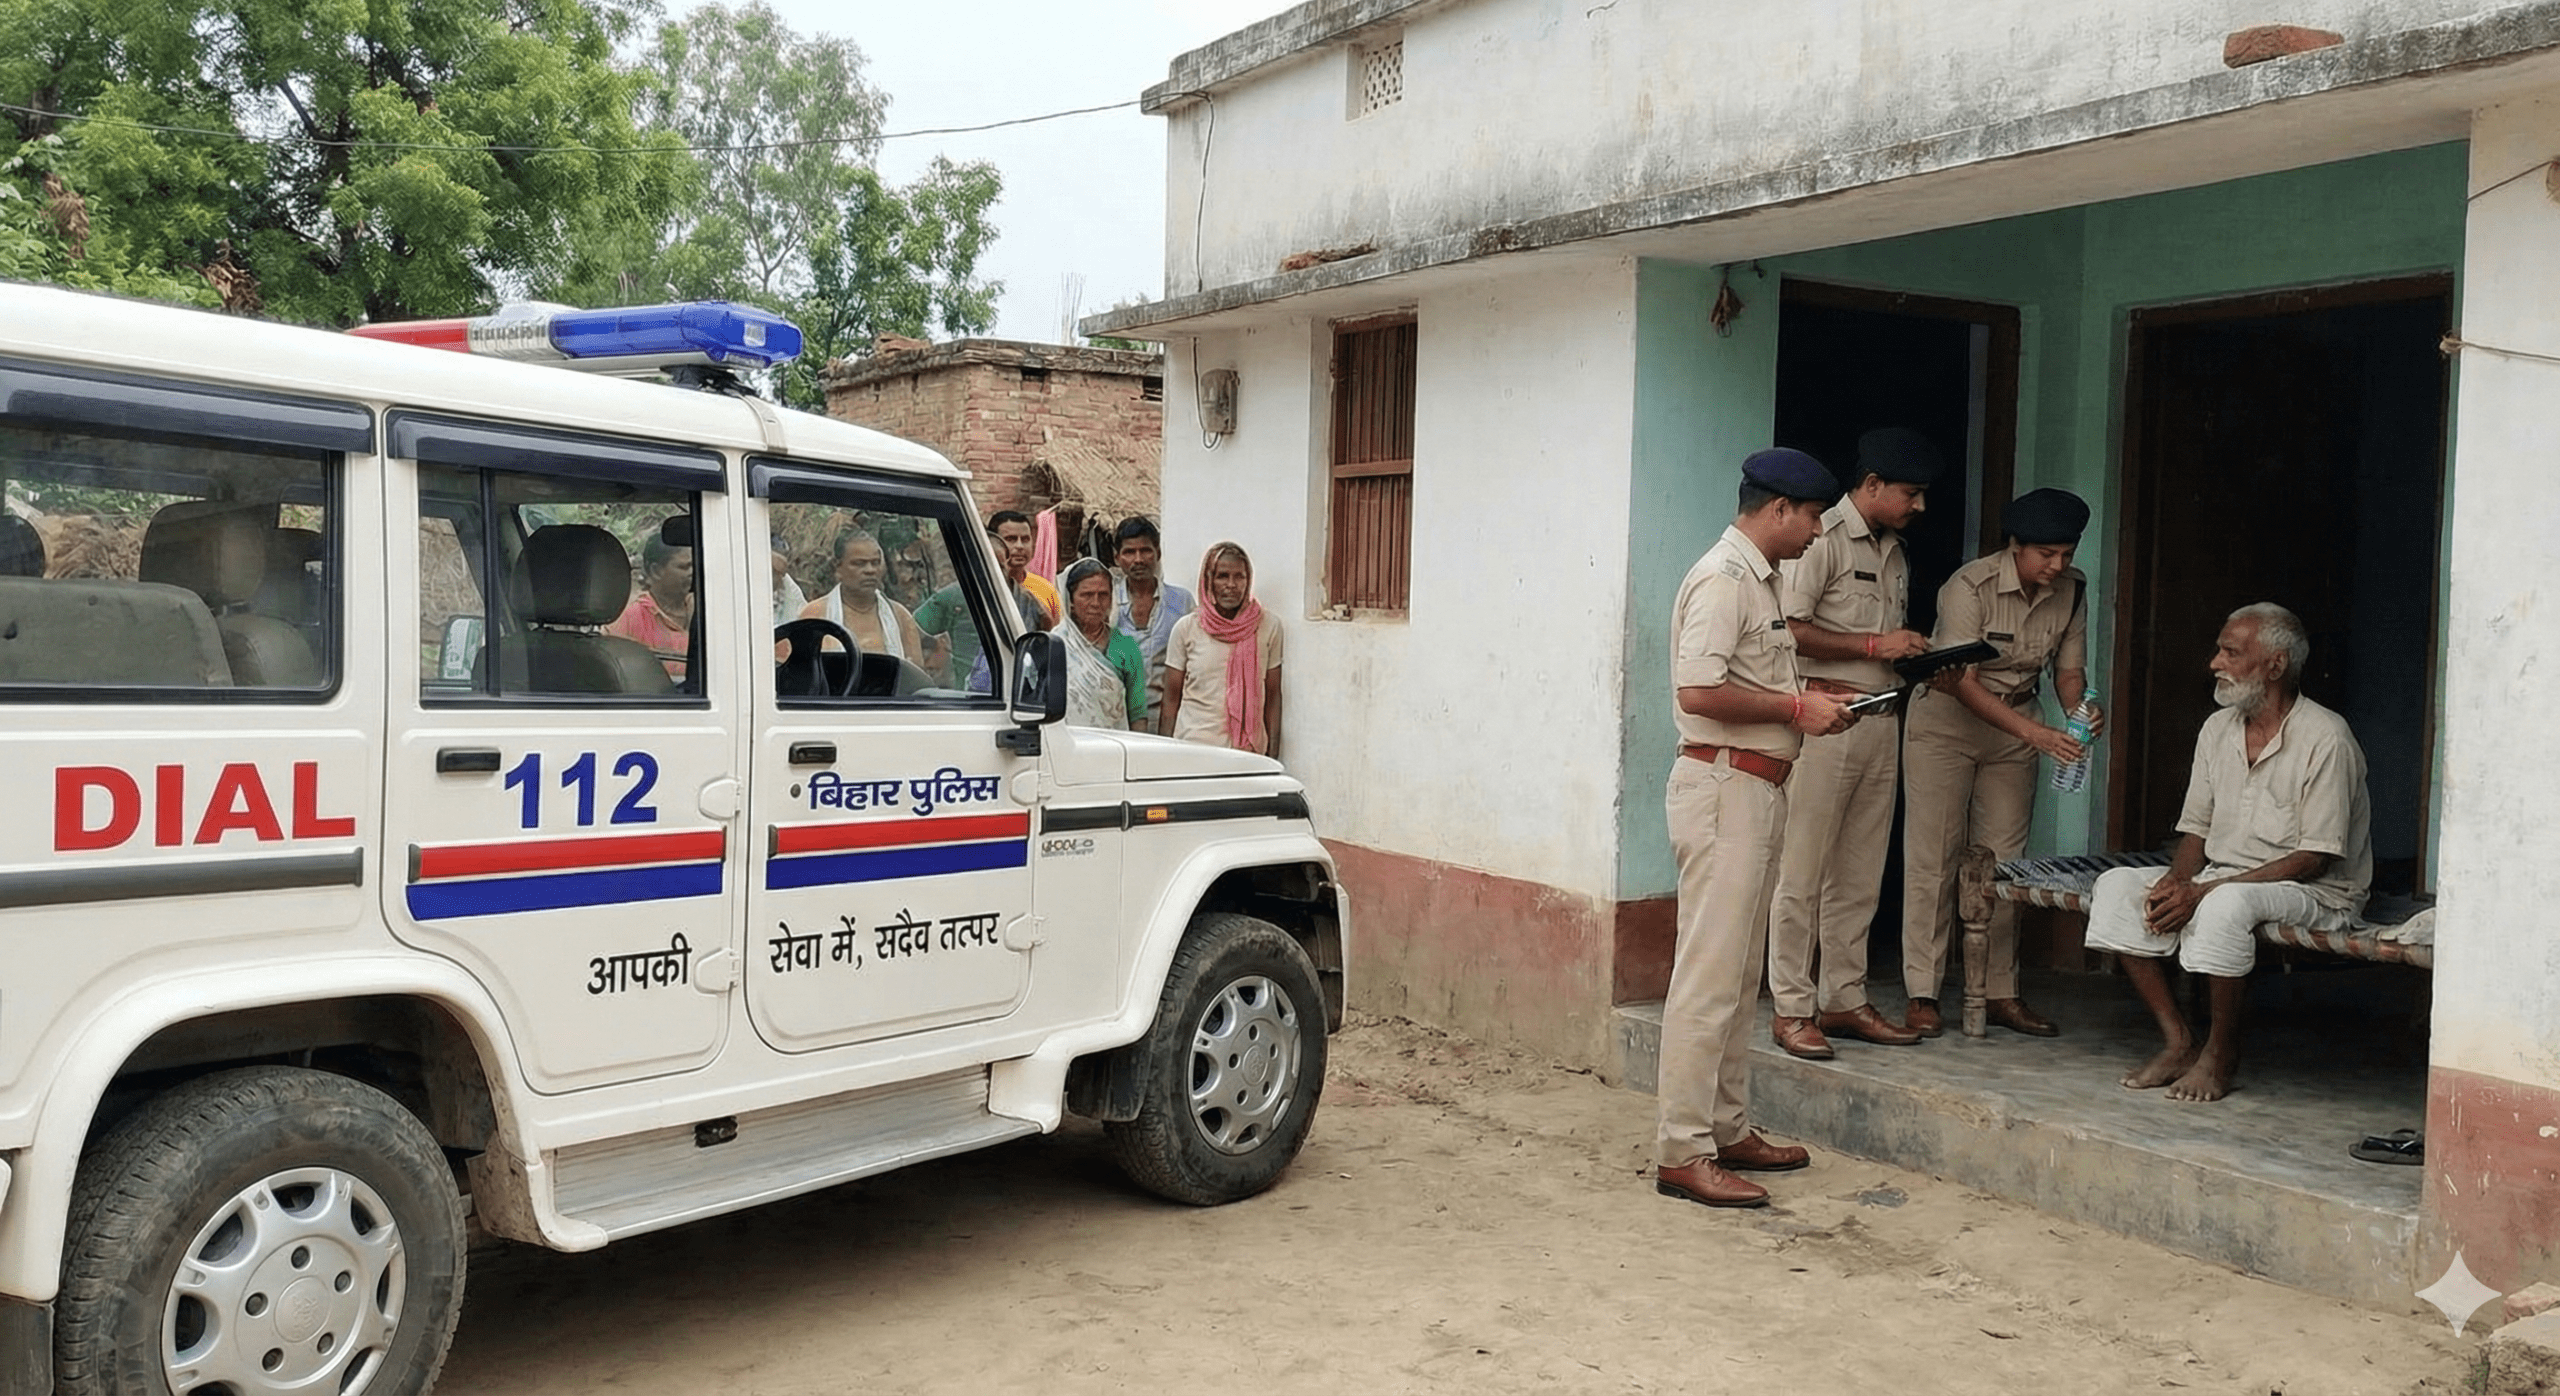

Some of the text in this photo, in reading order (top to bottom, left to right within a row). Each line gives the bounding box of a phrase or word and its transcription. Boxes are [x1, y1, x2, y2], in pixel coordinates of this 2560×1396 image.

[54, 752, 660, 852] DIAL 112
[808, 767, 1000, 816] बिहार पुलिस
[587, 907, 1001, 995] आपकी सेवा में, सदैव तत्पर
